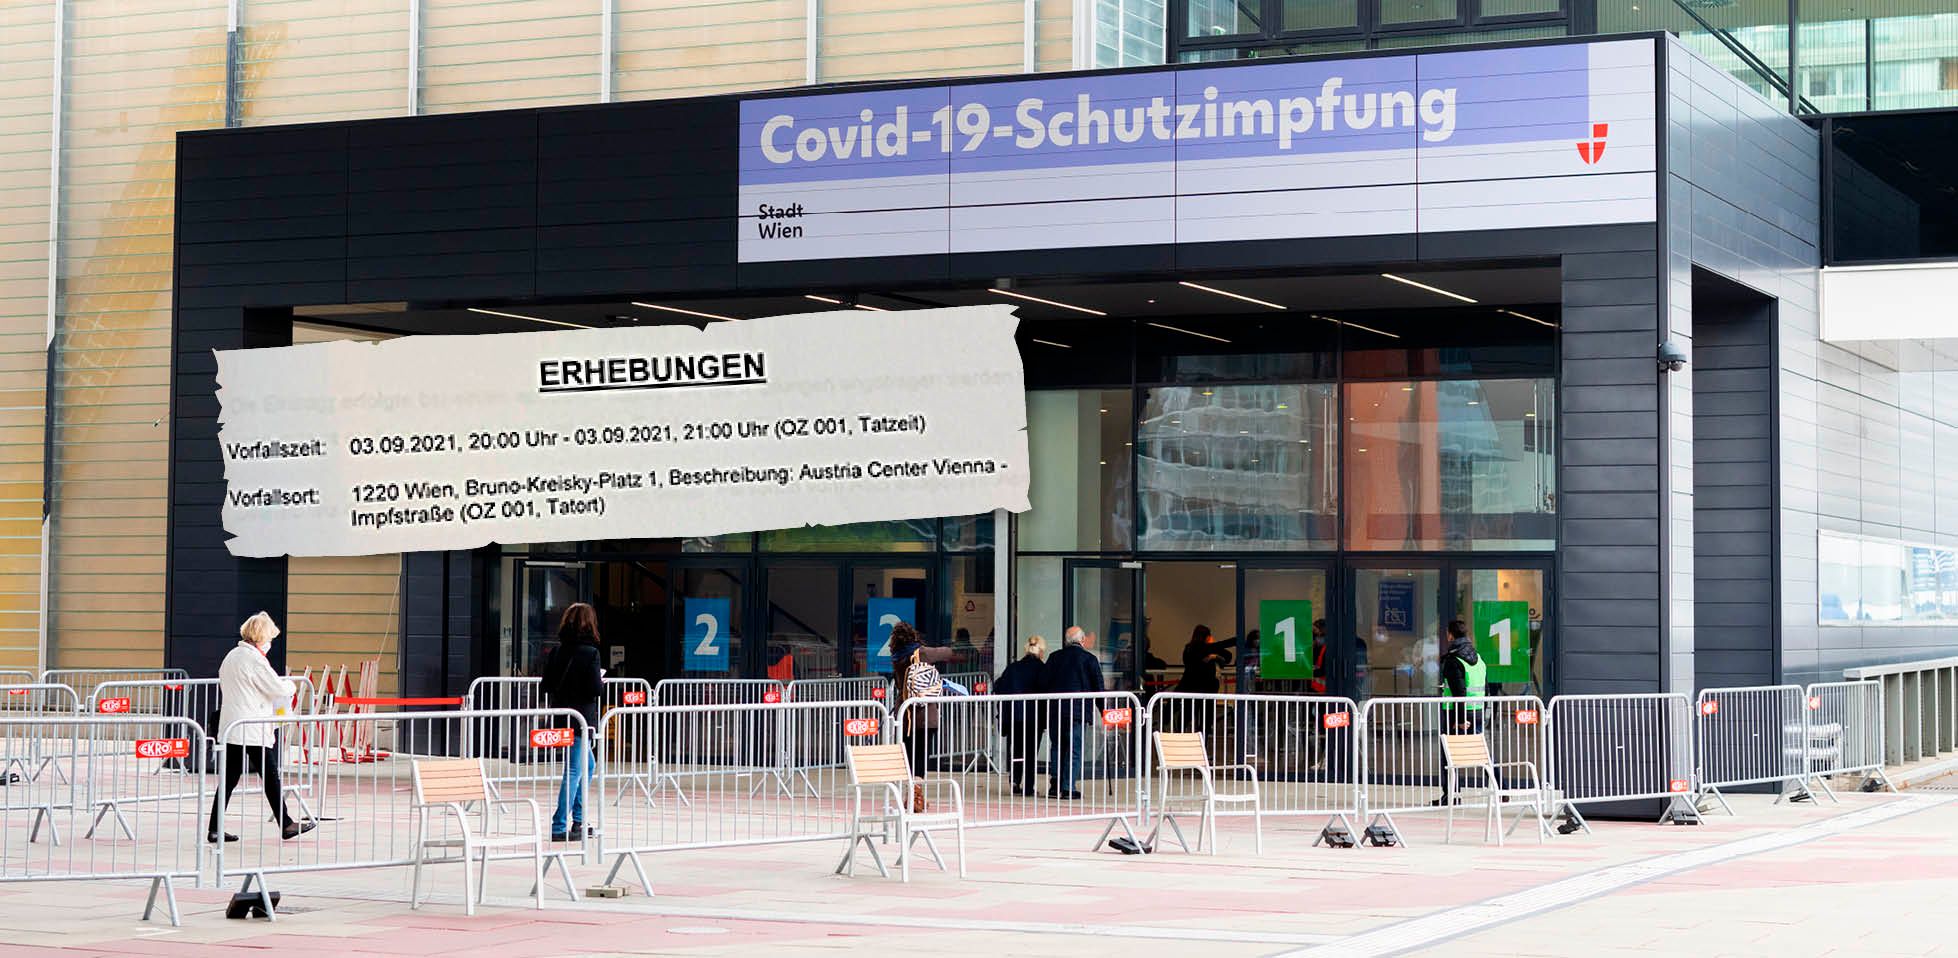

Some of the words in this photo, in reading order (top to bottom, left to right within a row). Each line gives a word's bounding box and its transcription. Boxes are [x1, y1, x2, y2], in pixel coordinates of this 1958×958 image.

[760, 77, 1457, 164] Covid-19-Schutzimpfung
[758, 222, 803, 239] Wien
[759, 202, 804, 220] Stadt
[693, 613, 720, 656] 2
[877, 613, 903, 657] 2
[1273, 616, 1296, 663] 1
[1488, 617, 1512, 666] 1
